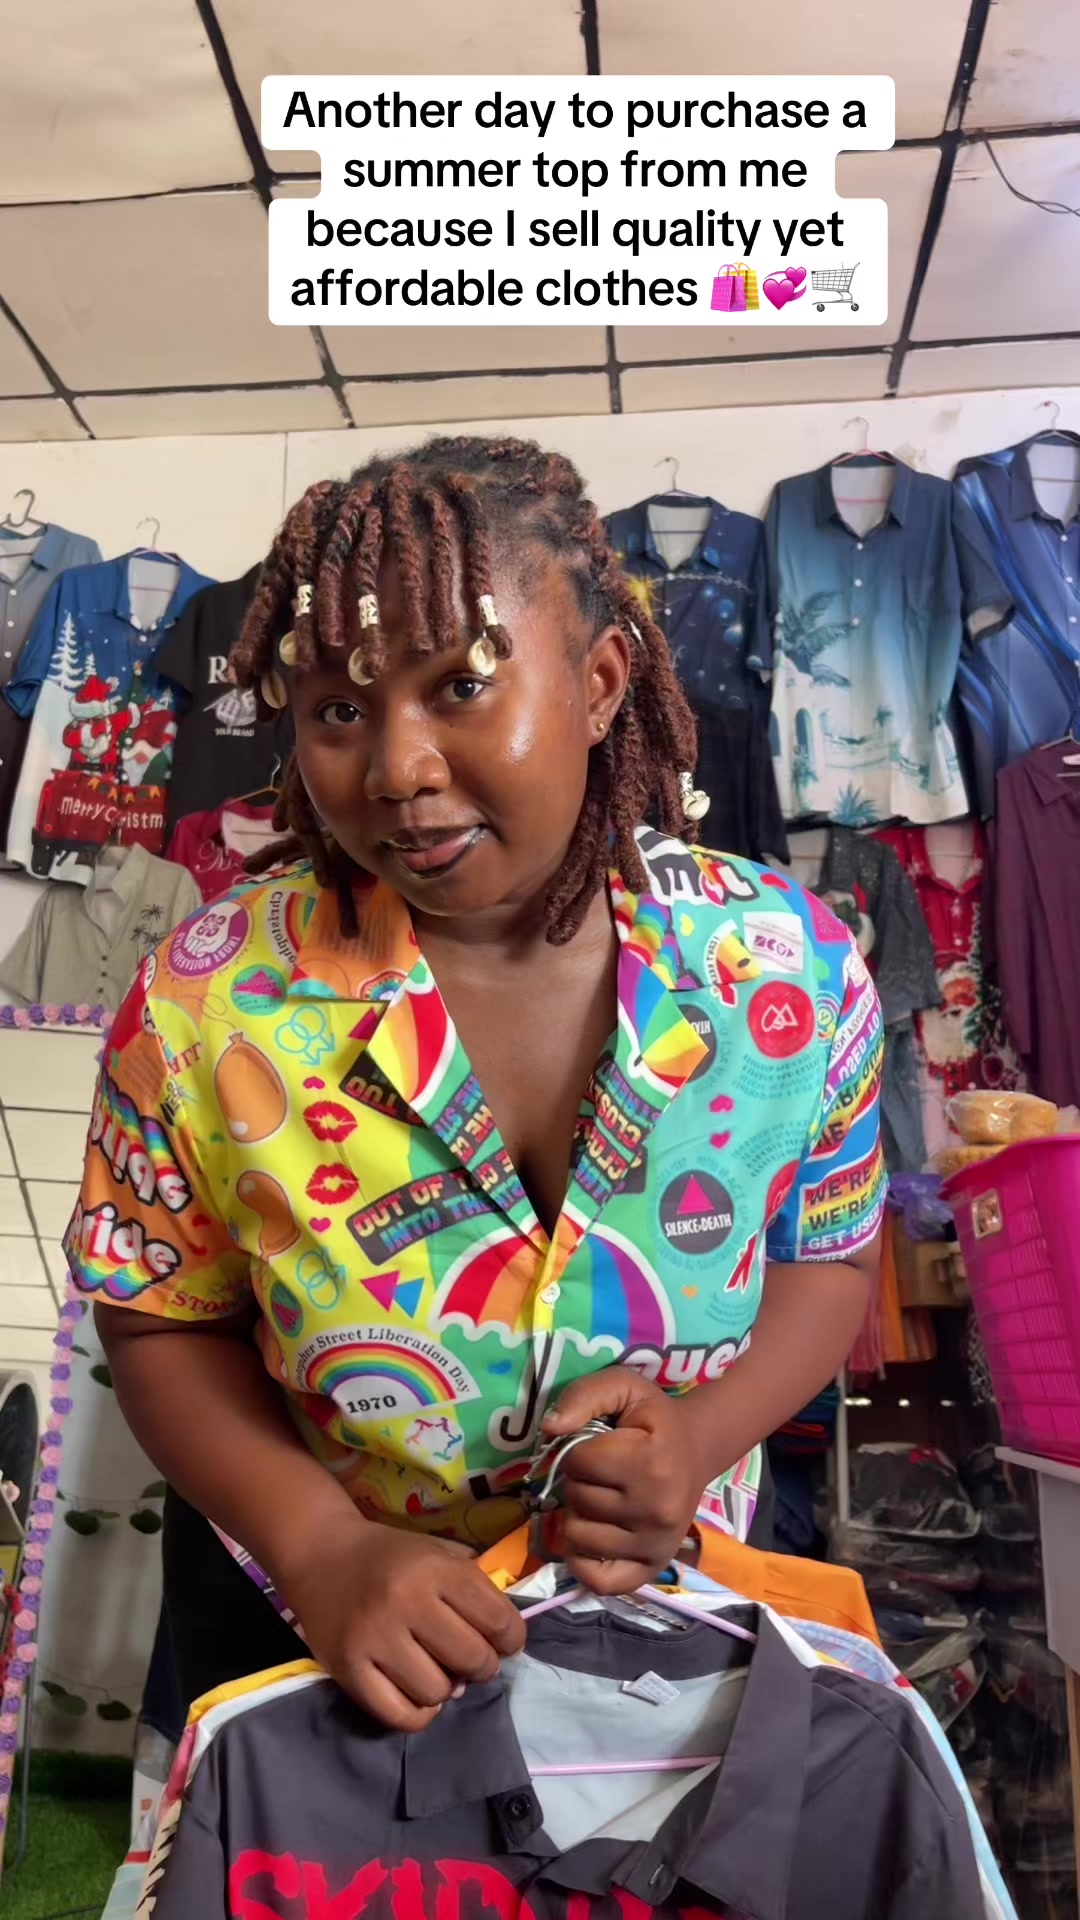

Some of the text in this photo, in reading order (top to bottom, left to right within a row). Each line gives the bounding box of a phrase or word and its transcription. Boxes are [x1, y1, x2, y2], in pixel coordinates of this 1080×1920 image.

[105, 806, 164, 829] Cristm
[352, 1194, 404, 1237] OUT
[409, 1175, 443, 1206] OF
[808, 1192, 869, 1231] WE'RE
[380, 1207, 441, 1253] INTO
[808, 1230, 847, 1250] GET
[316, 1328, 362, 1349] Street
[368, 1327, 448, 1367] Liberation
[448, 1366, 472, 1394] Day
[346, 1395, 398, 1413] 1970
